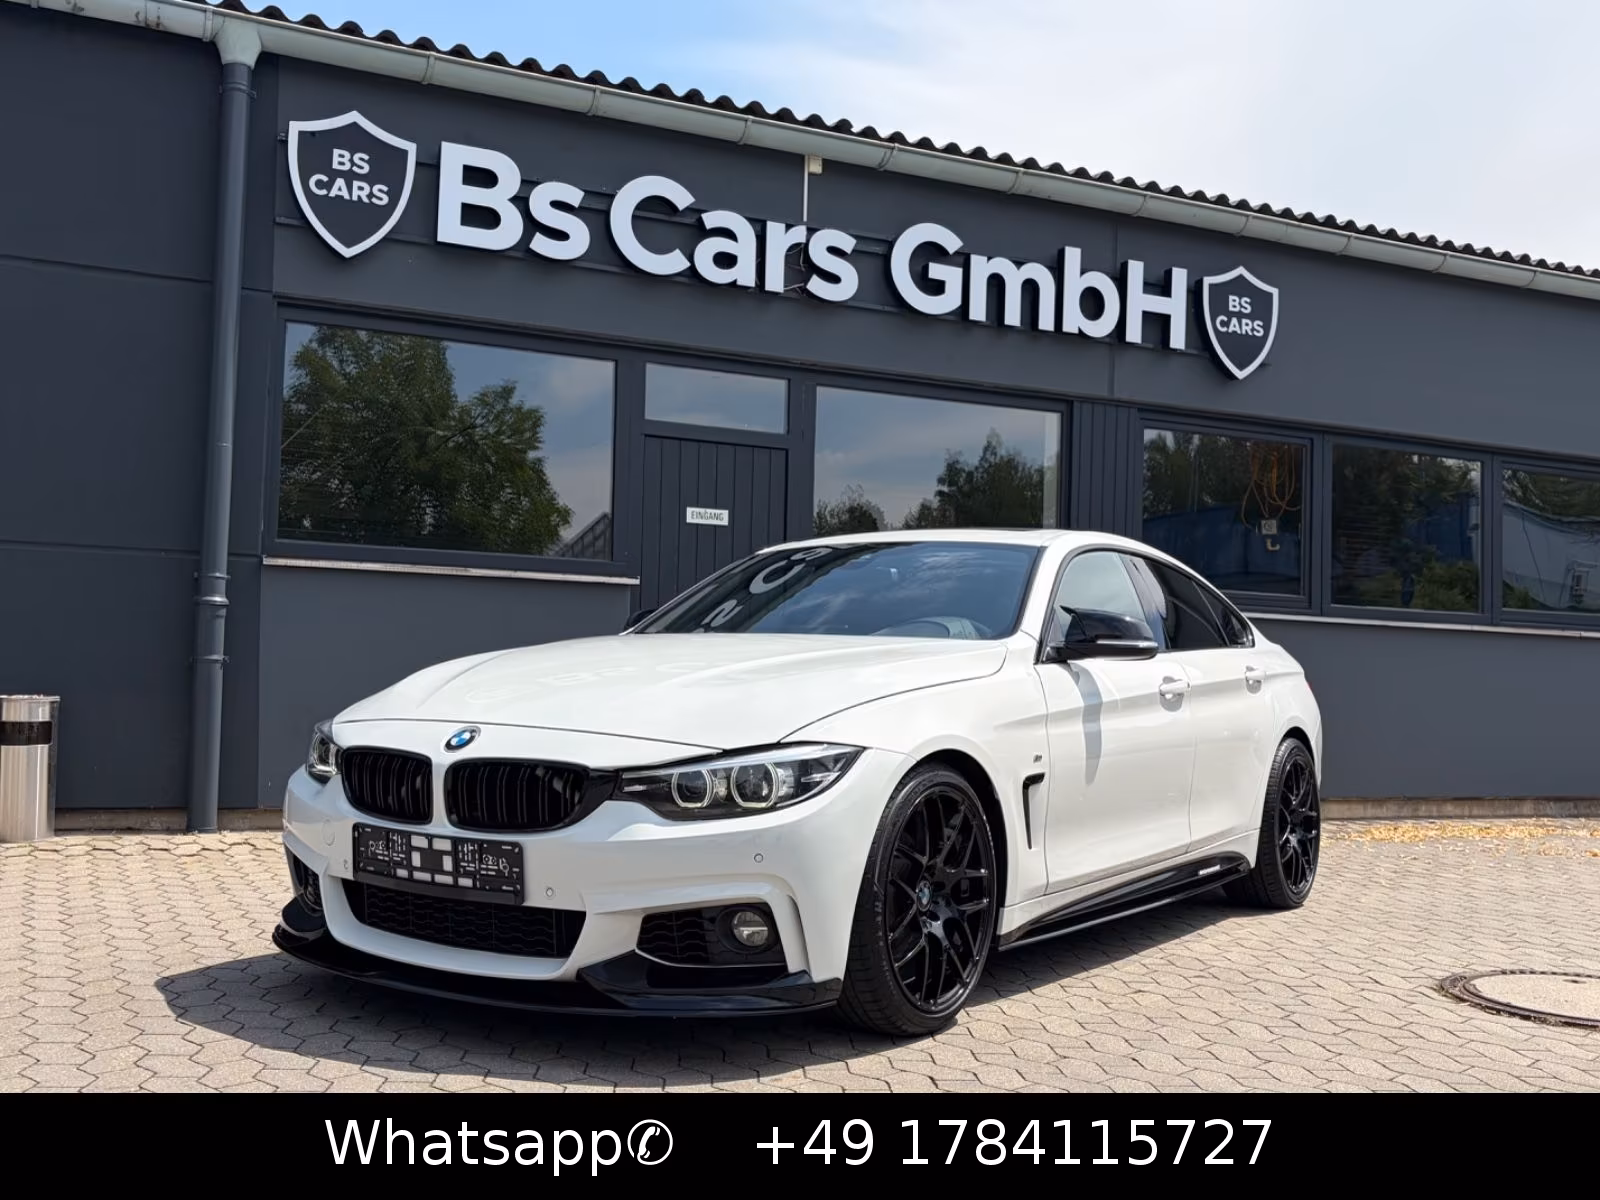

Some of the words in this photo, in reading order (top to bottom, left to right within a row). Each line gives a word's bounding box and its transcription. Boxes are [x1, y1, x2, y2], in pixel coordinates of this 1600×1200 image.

[331, 148, 370, 175] BS
[308, 173, 389, 206] CARS
[890, 222, 1188, 350] GmbH
[1228, 294, 1252, 314] BS
[1215, 314, 1265, 338] CARS
[691, 510, 724, 521] EINGANG
